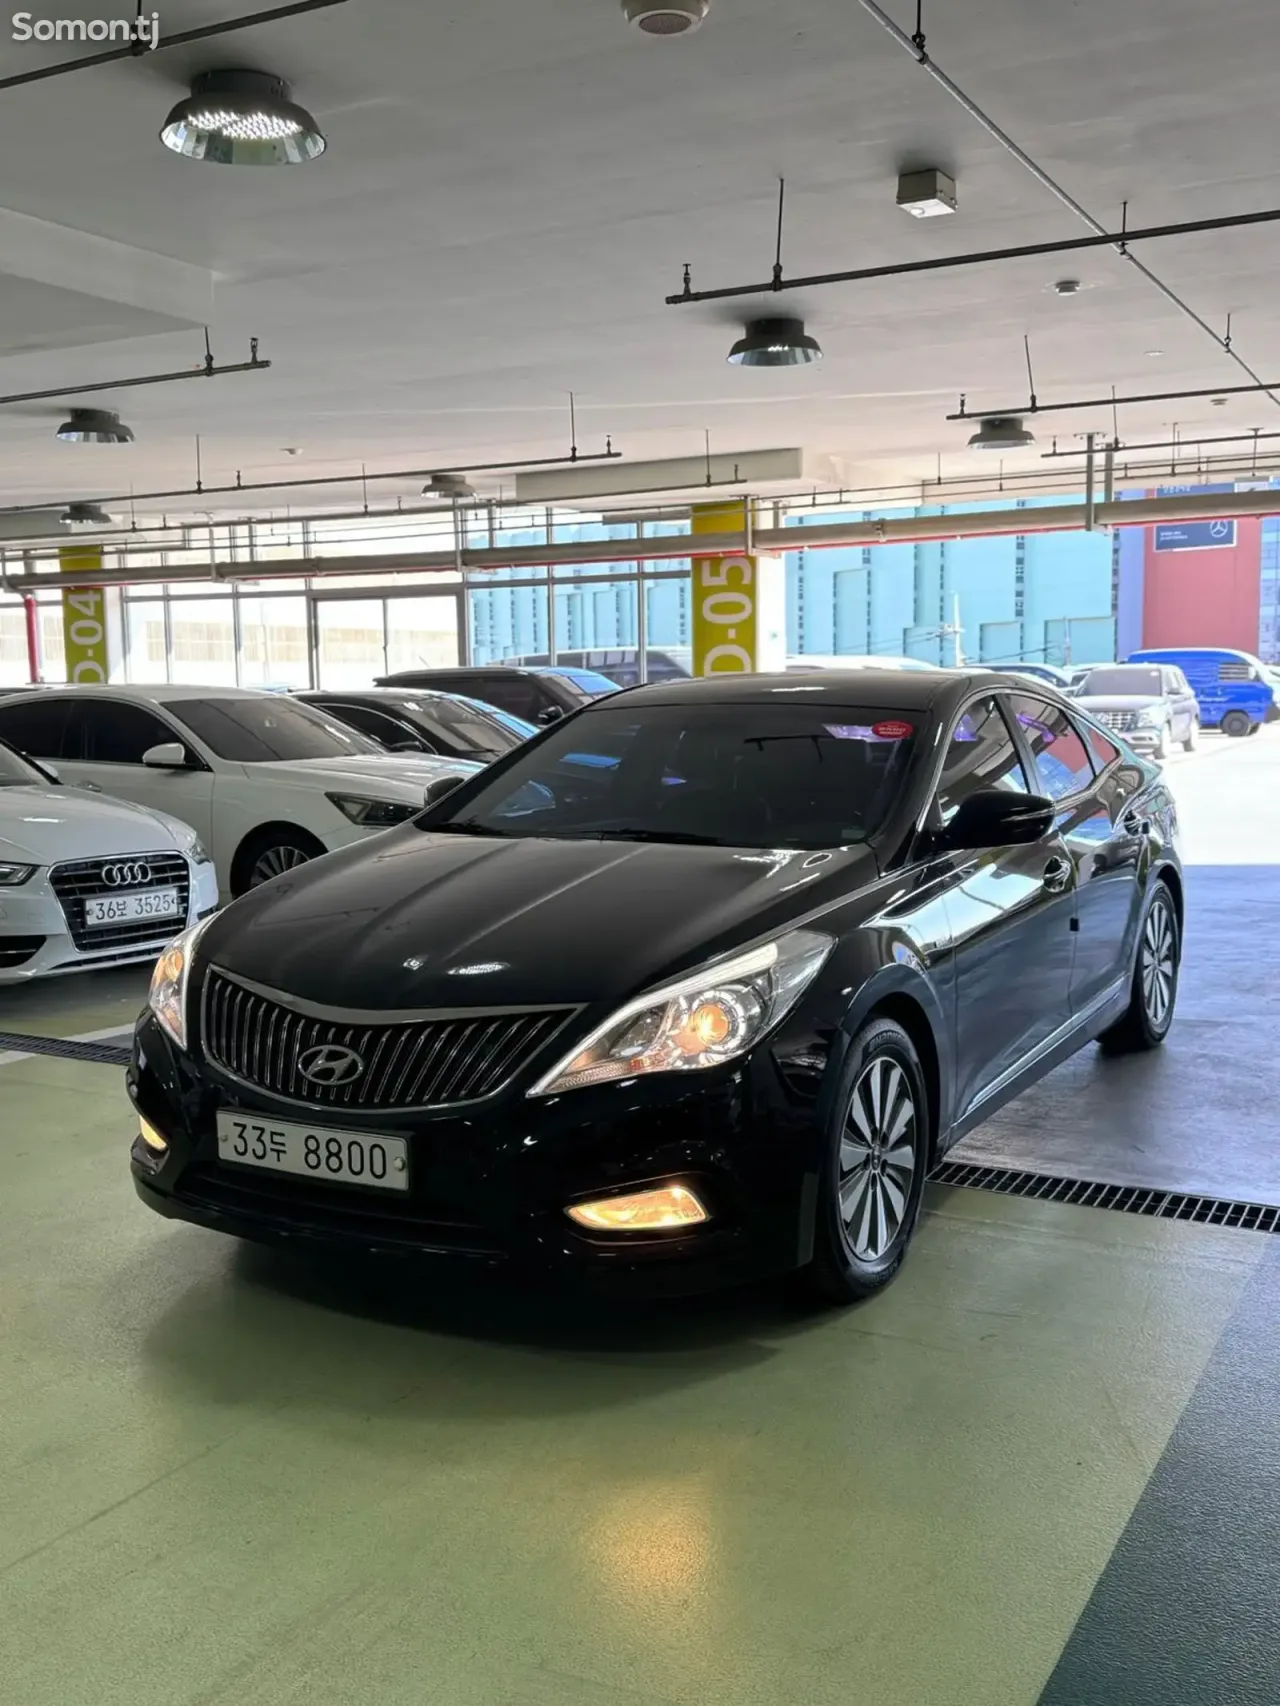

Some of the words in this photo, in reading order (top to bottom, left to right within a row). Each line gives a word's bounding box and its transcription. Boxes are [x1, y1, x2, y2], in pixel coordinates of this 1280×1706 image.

[134, 894, 171, 916] 3525
[232, 1121, 288, 1163] 33두
[303, 1134, 388, 1180] 8800
